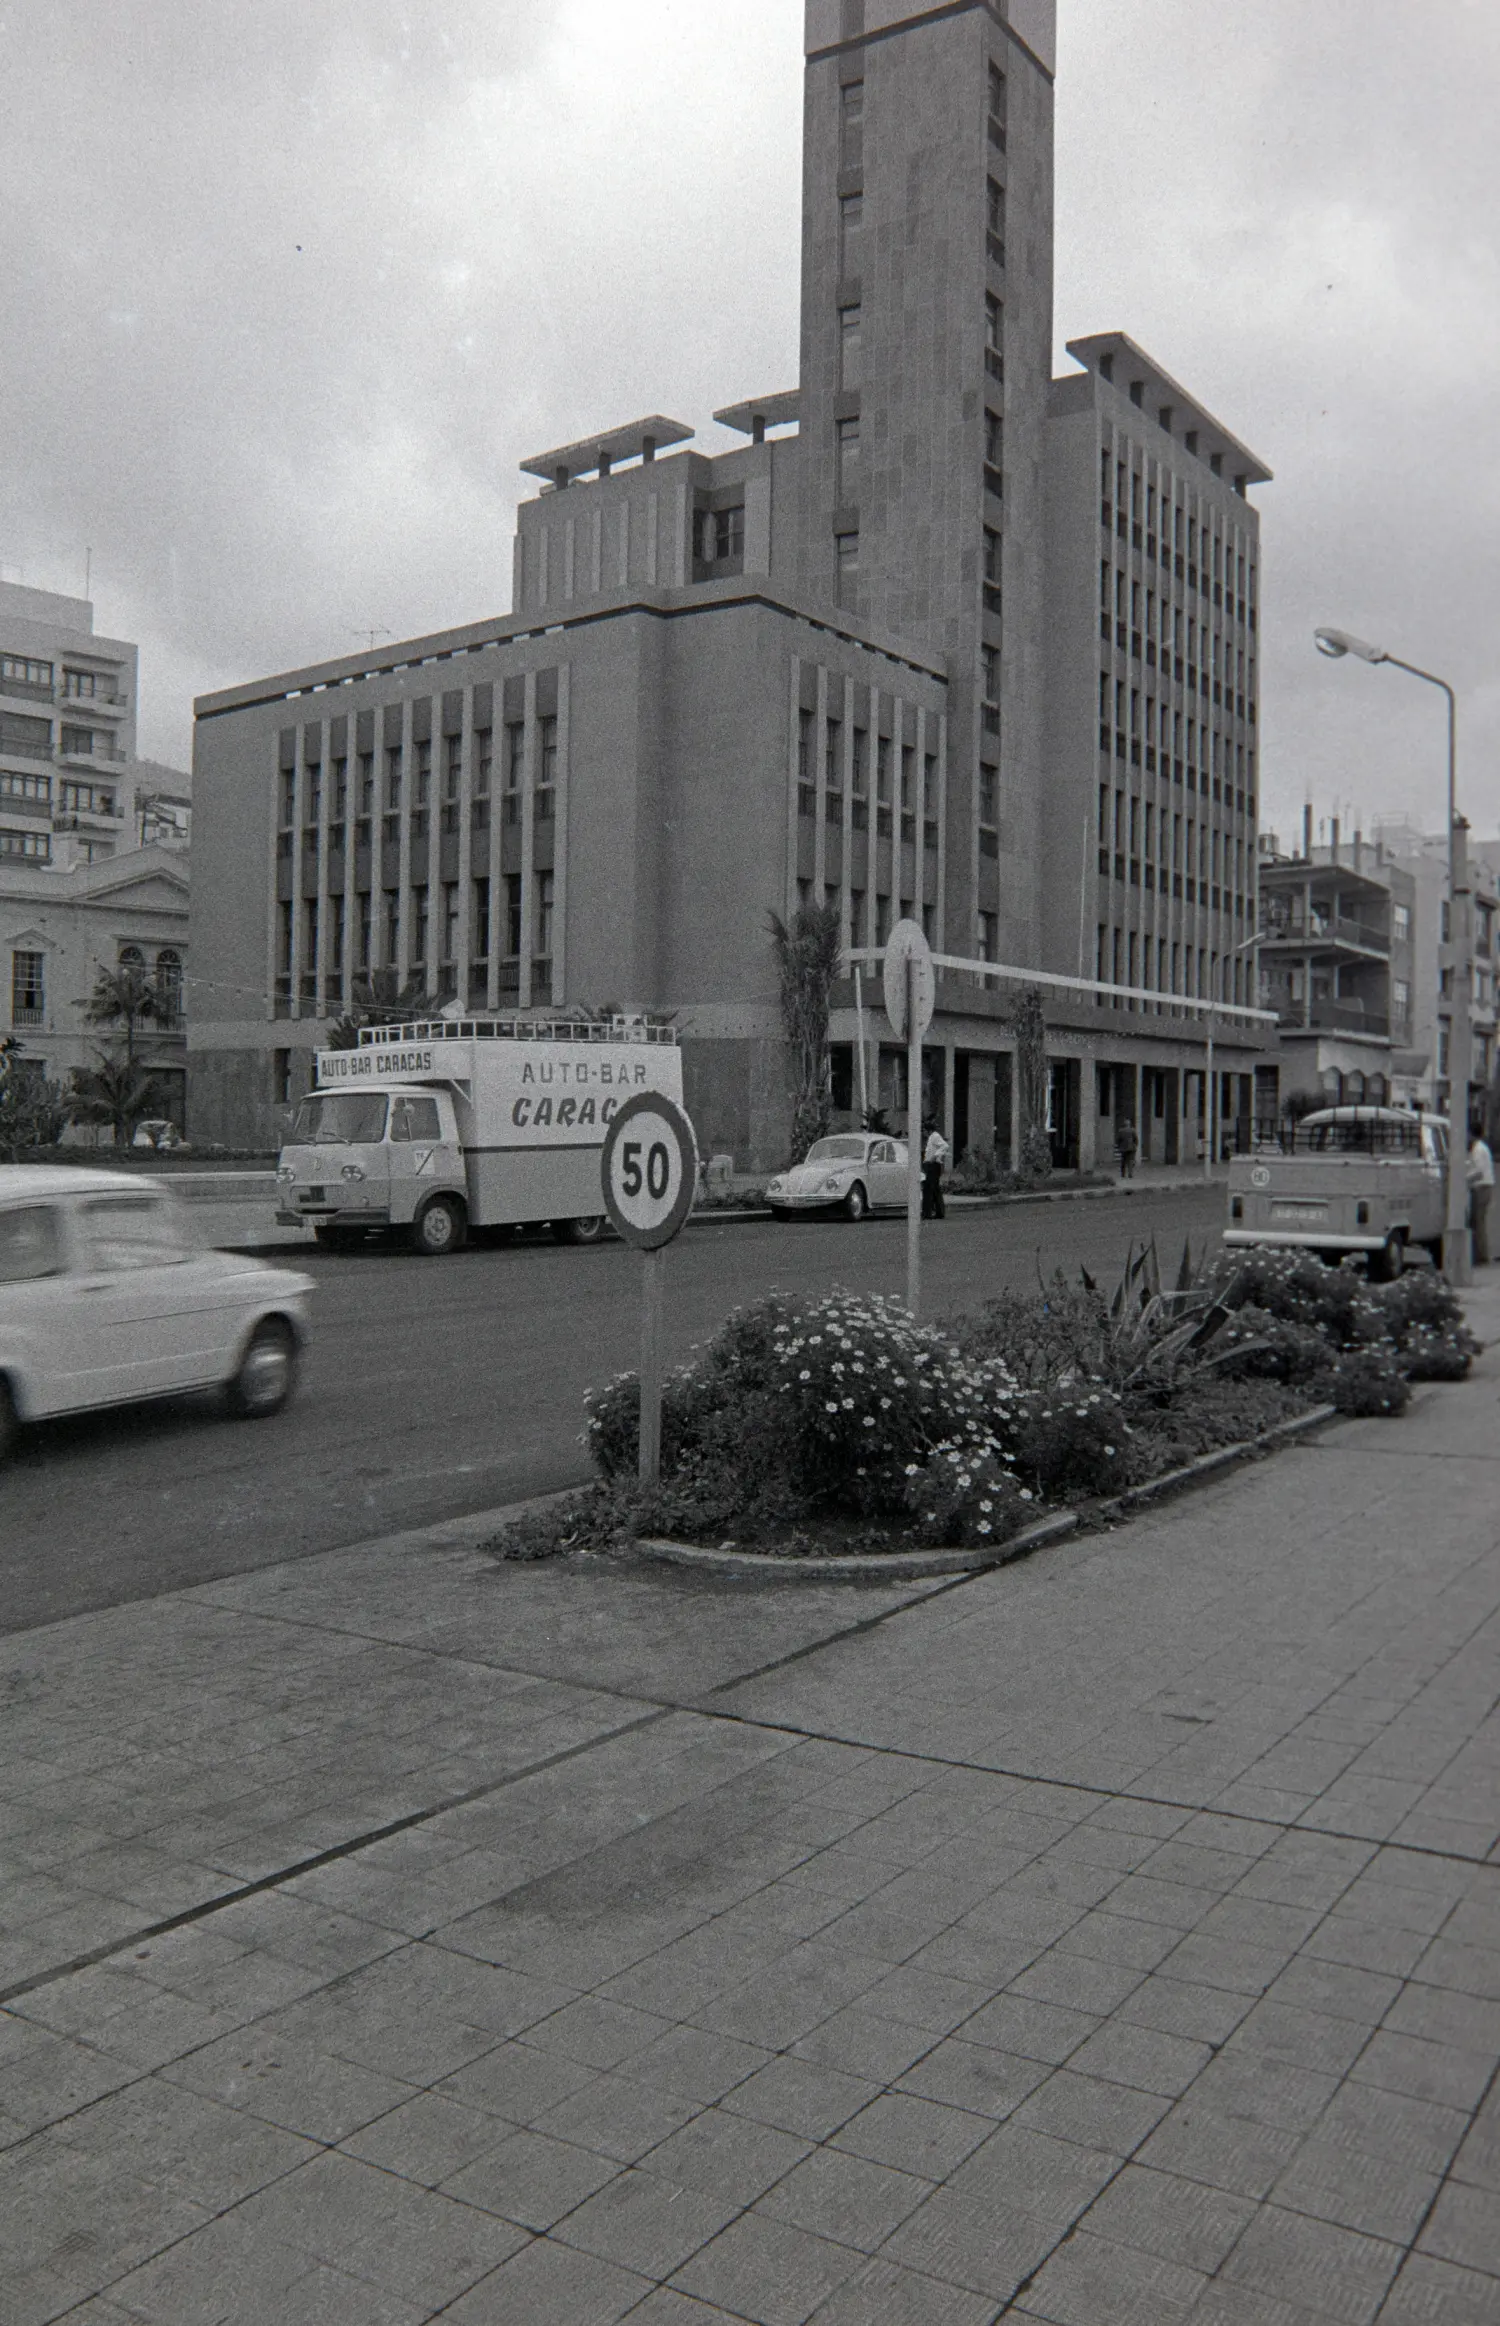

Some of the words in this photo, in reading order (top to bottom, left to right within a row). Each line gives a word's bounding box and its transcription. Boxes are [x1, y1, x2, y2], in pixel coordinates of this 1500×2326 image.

[321, 1056, 372, 1077] AUTO-BAR
[376, 1052, 431, 1074] CARACAS
[521, 1062, 647, 1084] AUTO-BAR
[622, 1141, 670, 1200] 50
